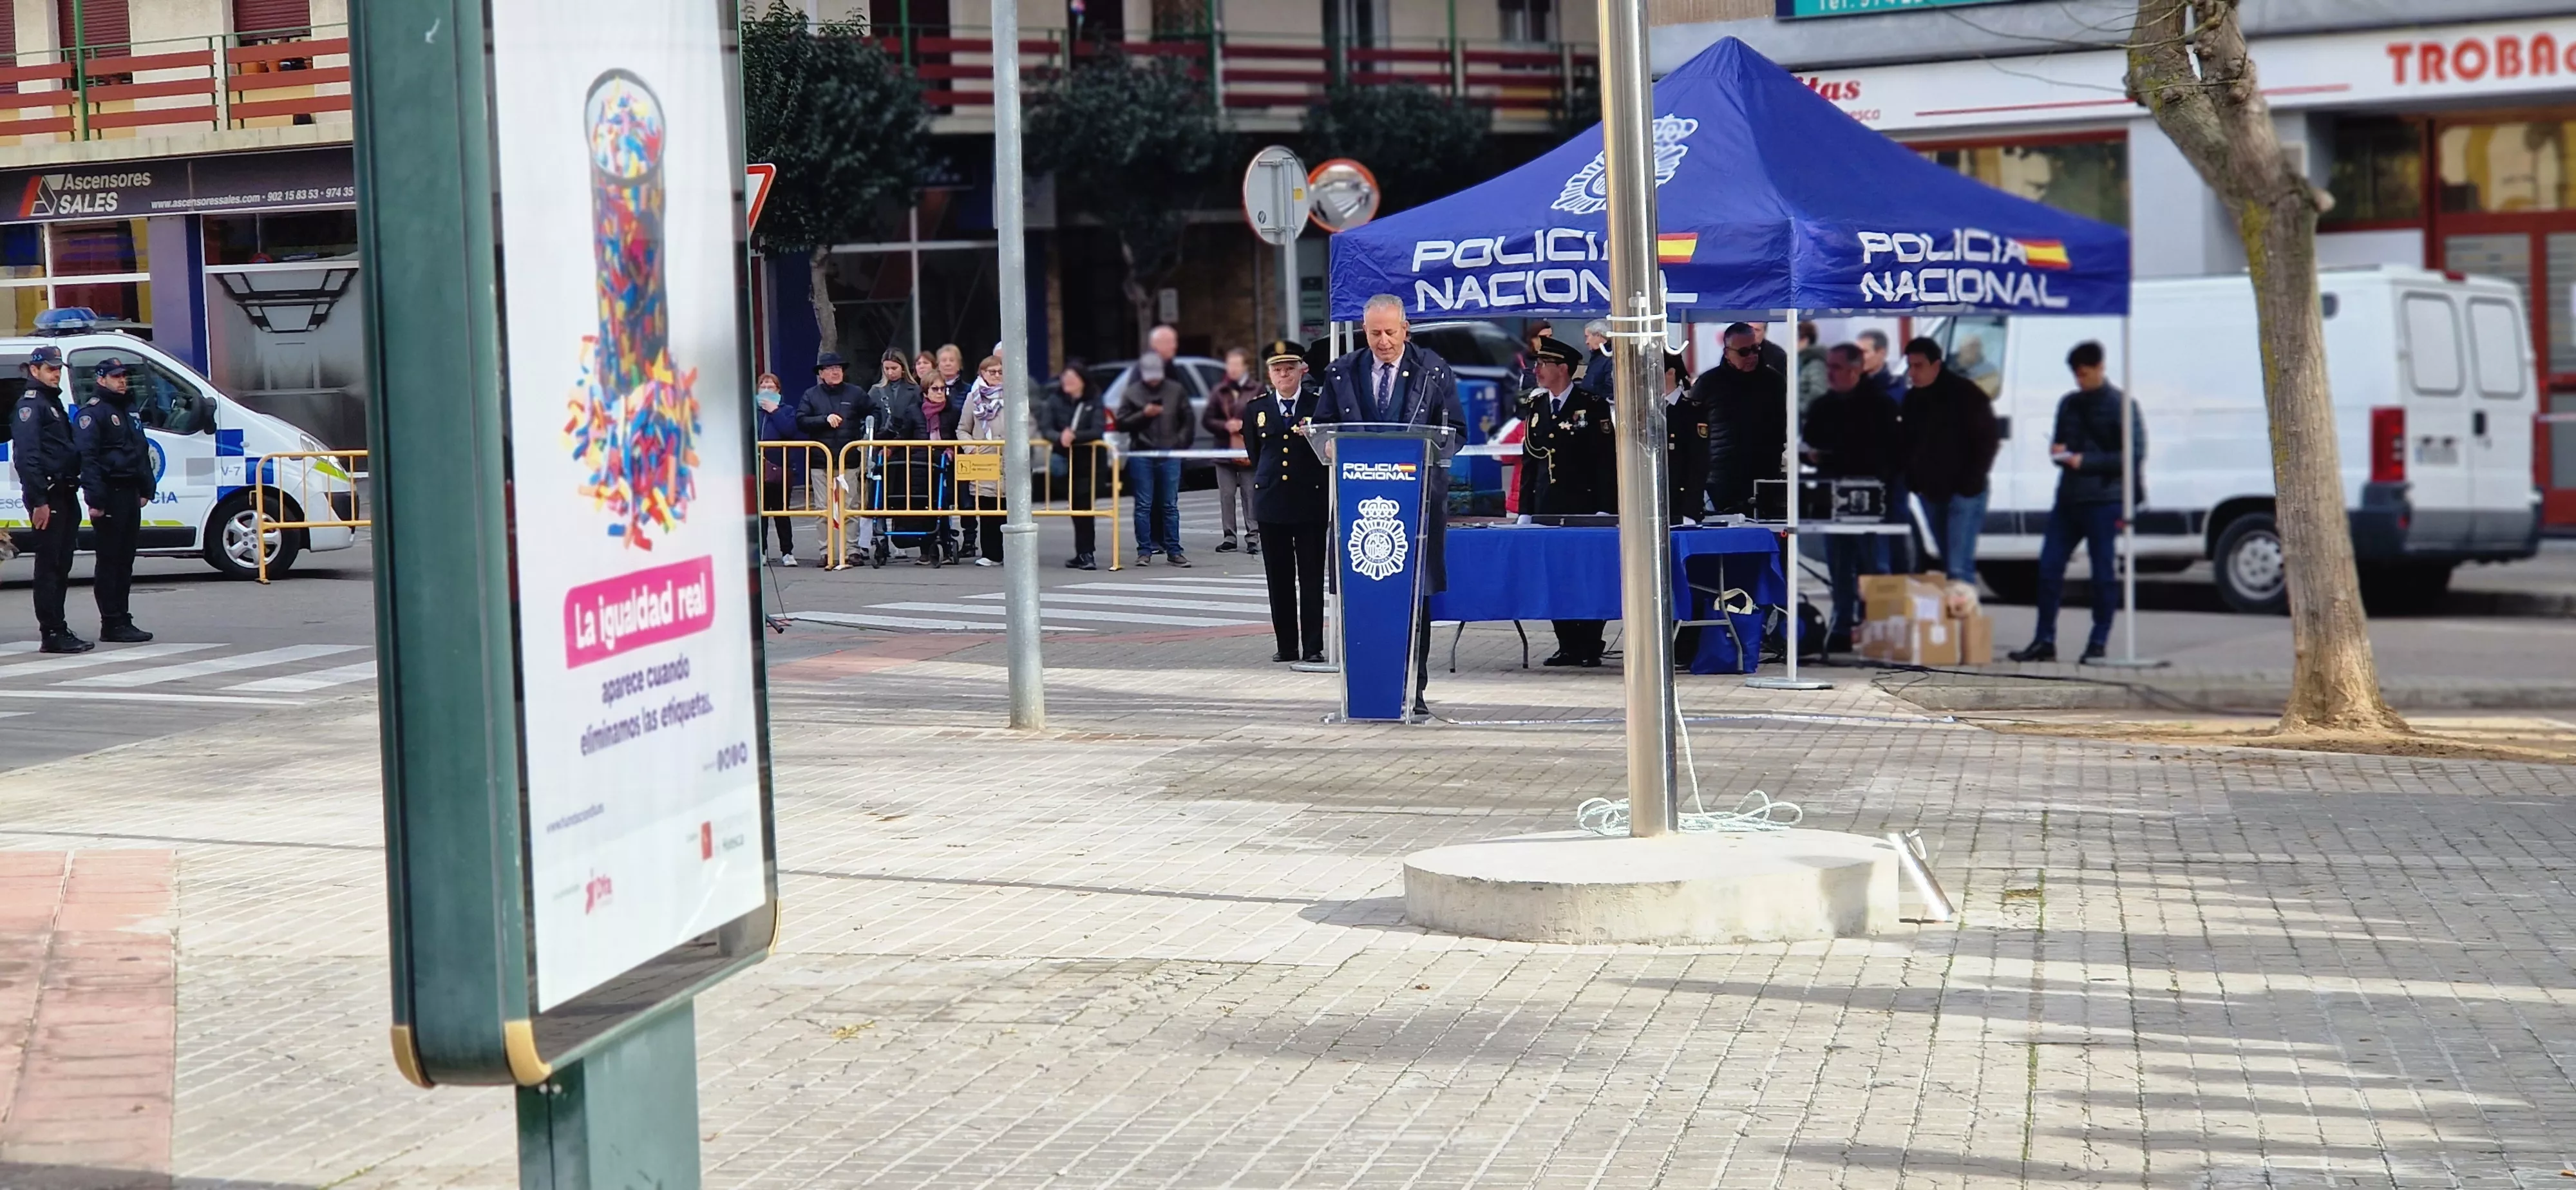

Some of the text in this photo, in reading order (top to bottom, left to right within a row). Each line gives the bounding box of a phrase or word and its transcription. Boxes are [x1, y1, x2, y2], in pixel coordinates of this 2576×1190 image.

[1844, 109, 1881, 121] esca
[64, 172, 152, 191] Ascensores
[59, 191, 118, 214] SALES
[151, 194, 261, 209] www.ascensoressales.com
[267, 192, 283, 202] 902
[285, 191, 294, 200] 15
[296, 189, 307, 200] 83
[308, 189, 319, 199] 53
[325, 187, 341, 198] 974
[1413, 227, 1608, 271] POLICI
[1858, 228, 2028, 265] POLICIA
[1414, 269, 1698, 311] NACIONL
[1861, 269, 2069, 308] NACIONAL
[221, 466, 241, 477] V-7
[1343, 462, 1401, 471] POLICIA
[1343, 471, 1416, 480] NACIONAL
[575, 571, 708, 650] La igualdad real
[602, 653, 690, 708] aparece cuando
[580, 714, 641, 756] eliminamos
[641, 707, 658, 733] las
